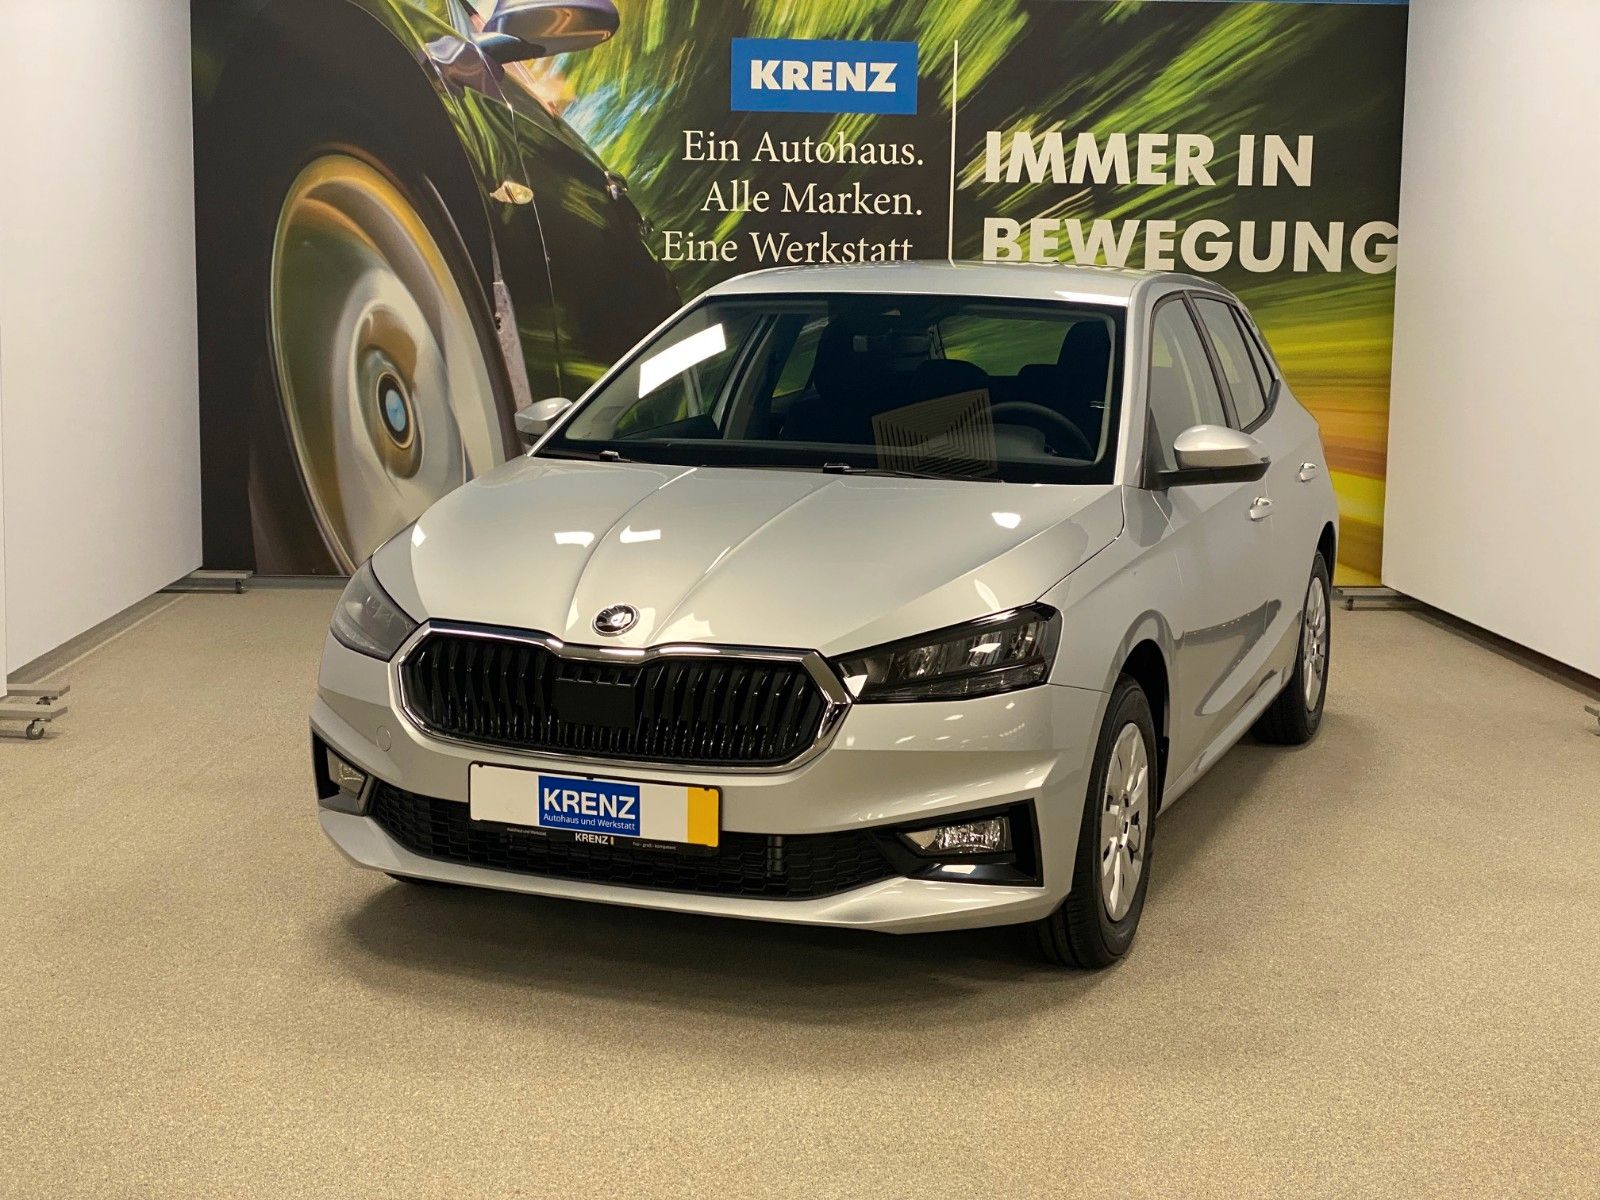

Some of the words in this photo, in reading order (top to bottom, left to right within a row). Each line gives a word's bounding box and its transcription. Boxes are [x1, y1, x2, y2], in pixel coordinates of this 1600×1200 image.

[750, 60, 898, 93] KRENZ
[682, 130, 741, 162] Ein
[751, 131, 924, 166] Autohaus.
[984, 131, 1216, 186] IMMER
[1237, 134, 1314, 187] IN
[700, 180, 770, 212] Alle
[780, 182, 922, 216] Marken.
[661, 230, 738, 262] Eine
[749, 230, 914, 264] Werkstatt
[983, 217, 1399, 275] BEWEGUNG
[543, 787, 636, 820] KRENZ
[543, 813, 580, 825] Autohaus
[597, 820, 636, 831] Werkstatt
[575, 832, 609, 845] KRENZ
